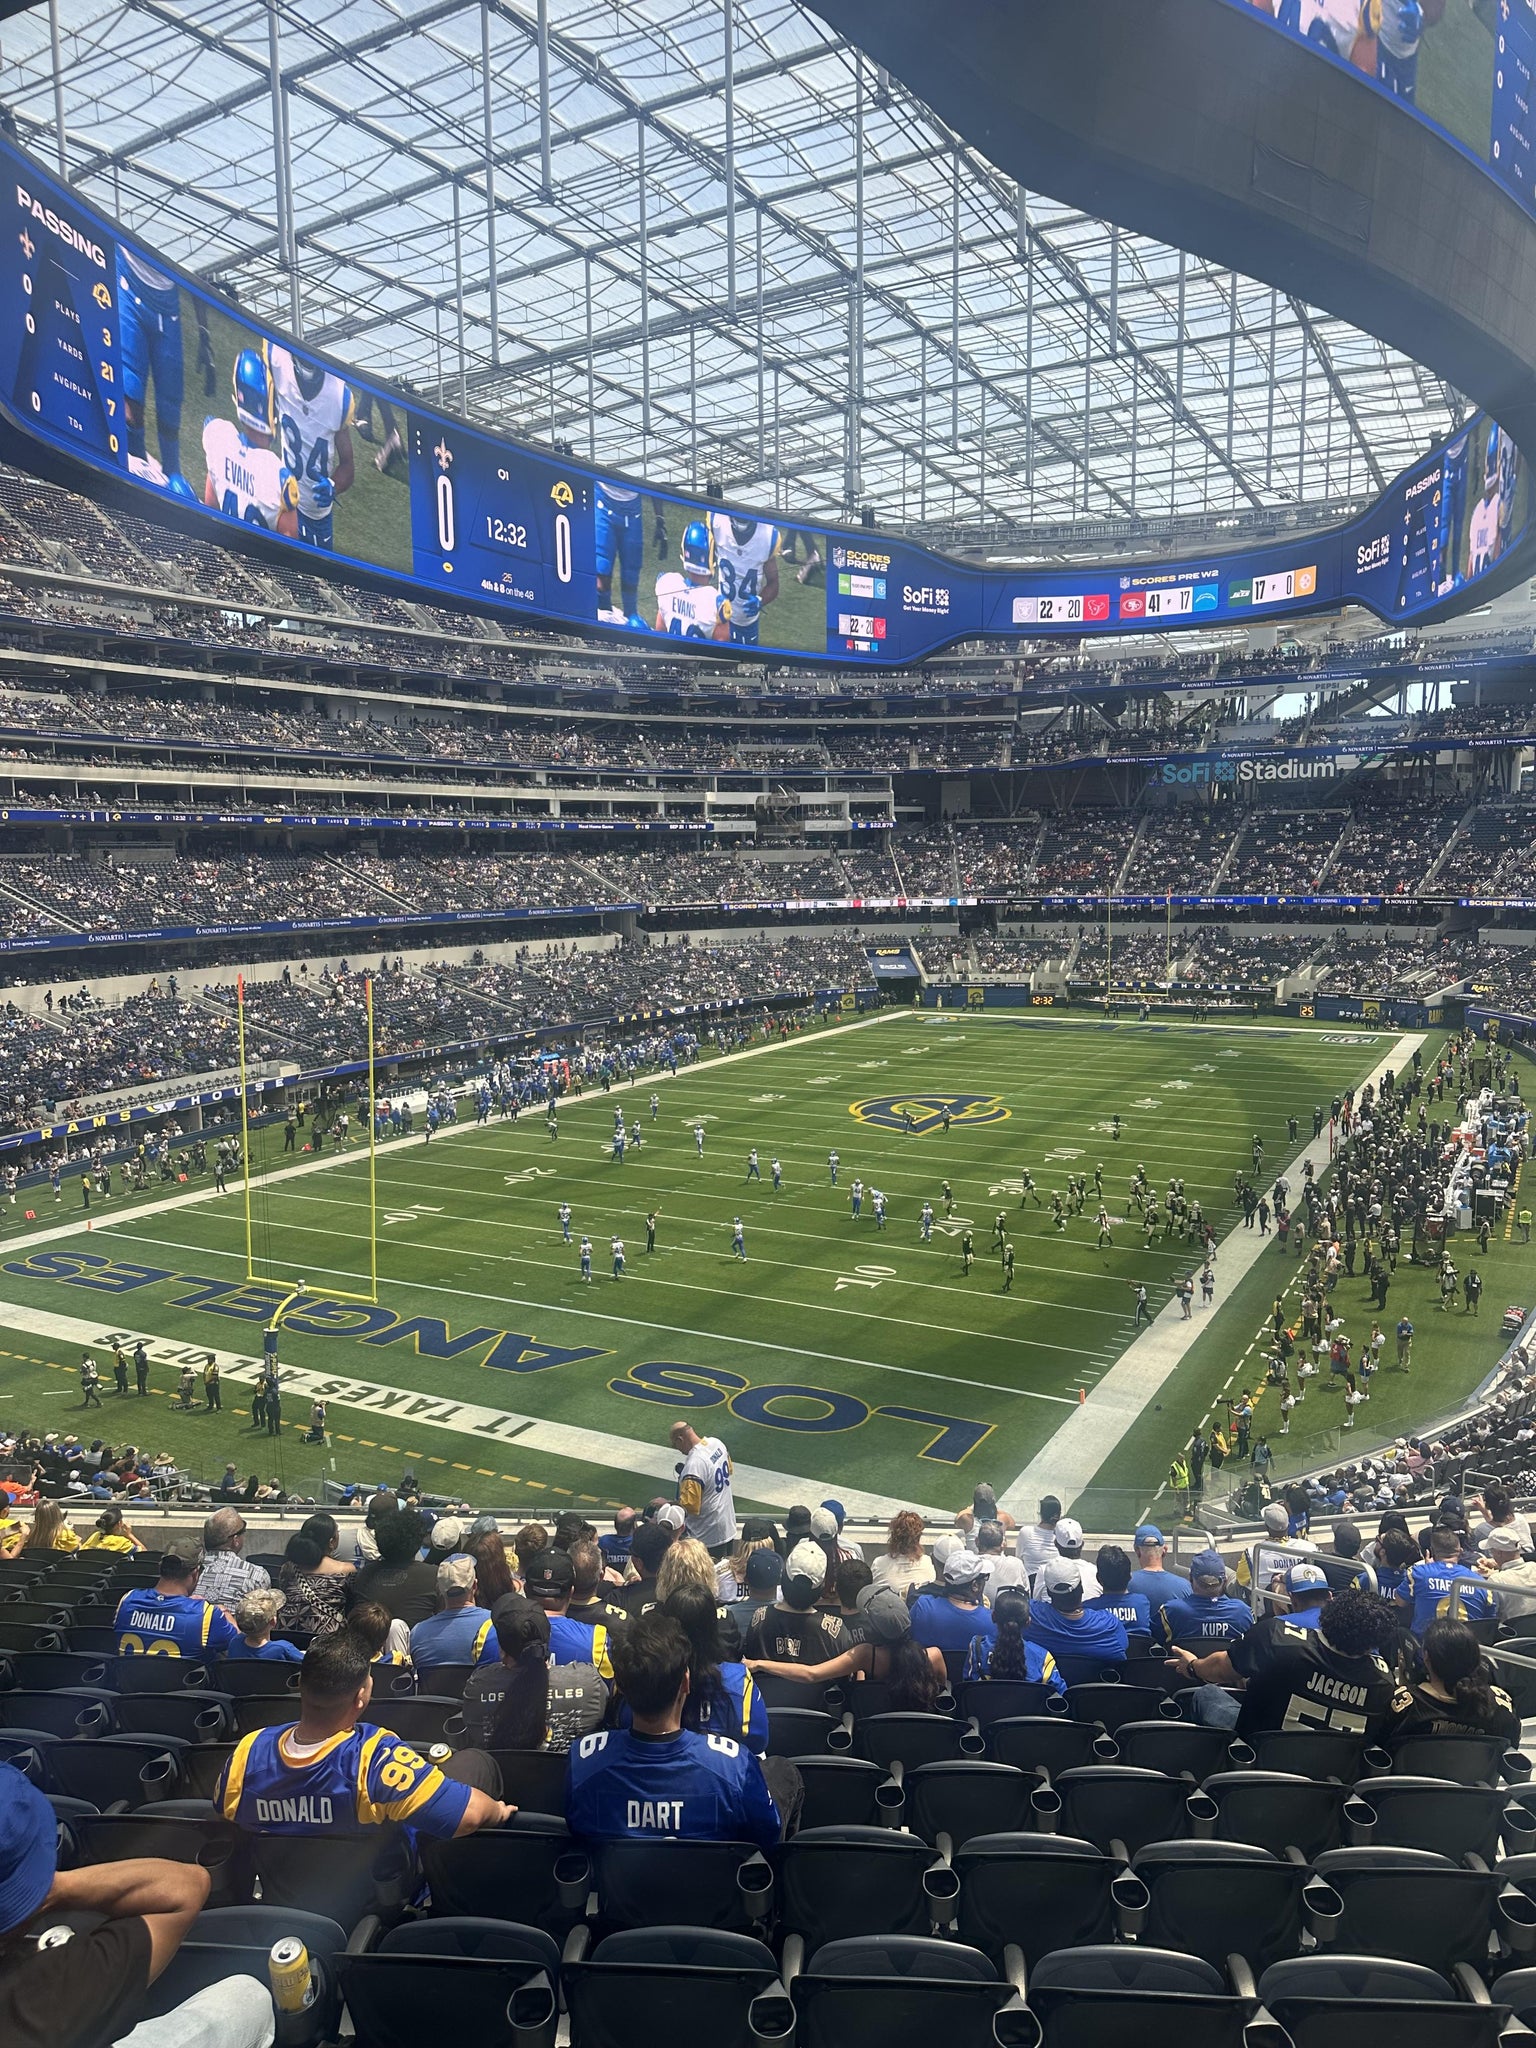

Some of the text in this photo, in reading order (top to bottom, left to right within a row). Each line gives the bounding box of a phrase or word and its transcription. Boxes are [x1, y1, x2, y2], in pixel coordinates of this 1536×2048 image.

[16, 184, 107, 270] PASSING
[23, 273, 33, 295] 0
[55, 299, 81, 324] PLAYS
[25, 313, 35, 335] 0
[102, 327, 112, 348] 3
[57, 338, 83, 361] YARDS
[101, 361, 114, 383] 21
[31, 391, 41, 413] 0
[107, 398, 117, 417] 7
[68, 416, 83, 432] TDs
[109, 434, 119, 453] 0
[225, 456, 255, 498] EVANS
[1405, 468, 1441, 501] PASSING
[437, 475, 455, 551] 0
[486, 516, 527, 548] 12:32
[555, 514, 572, 583] 0
[846, 550, 891, 565] SCORES
[1357, 538, 1381, 565] SoFi
[846, 558, 888, 573] PRE W2
[502, 572, 513, 584] 25
[1132, 569, 1219, 586] SCORES PRE W2
[481, 579, 535, 601] 4th & 8 on the 48
[903, 585, 934, 605] SoFi
[1255, 579, 1266, 600] 17
[1286, 577, 1292, 595] 0
[672, 597, 696, 620] EVANS
[1040, 600, 1053, 619] 22
[1068, 599, 1081, 618] 20
[1148, 593, 1161, 613] 41
[1180, 590, 1191, 610] 17
[850, 618, 859, 633] 22
[1424, 663, 1451, 671] NOVARTIS
[1223, 688, 1248, 697] PEPSI
[1315, 682, 1340, 690] PEPSI
[1162, 759, 1335, 785] SoFi Stadium
[311, 817, 317, 825] 0
[343, 818, 350, 826] 0
[401, 819, 407, 827] 0
[560, 822, 565, 830] 0
[95, 934, 124, 942] NOVARTIS
[202, 927, 228, 935] NOVARTIS
[875, 948, 901, 957] RAMS
[1181, 983, 1241, 991] HOUSE
[693, 998, 745, 1011] HOUSE
[1032, 996, 1053, 1005] 12:32
[1301, 1006, 1314, 1016] 25
[618, 1009, 663, 1023] RAMS
[1428, 1009, 1445, 1025] RAMS
[190, 1078, 284, 1106] HOUSE
[41, 1110, 131, 1140] RAMS
[1044, 1147, 1086, 1162] 40
[504, 1165, 558, 1186] 20
[987, 1178, 1026, 1197] 30
[382, 1202, 445, 1226] 10
[833, 1264, 897, 1292] 10
[92, 1331, 156, 1353] US
[1, 1250, 999, 1466] LOS ANGELES
[310, 1378, 464, 1424] TAKES
[473, 1416, 537, 1439] IT
[714, 1460, 730, 1493] 99
[1428, 1577, 1475, 1595] STAFRD
[129, 1610, 176, 1633] DONALD
[1201, 1622, 1229, 1637] KUPP
[480, 1692, 506, 1703] LOS
[547, 1687, 584, 1700] ELES
[1306, 1671, 1368, 1707] JACKSON
[380, 1743, 427, 1793] 99
[256, 1796, 334, 1825] DONALD
[626, 1799, 685, 1831] DART
